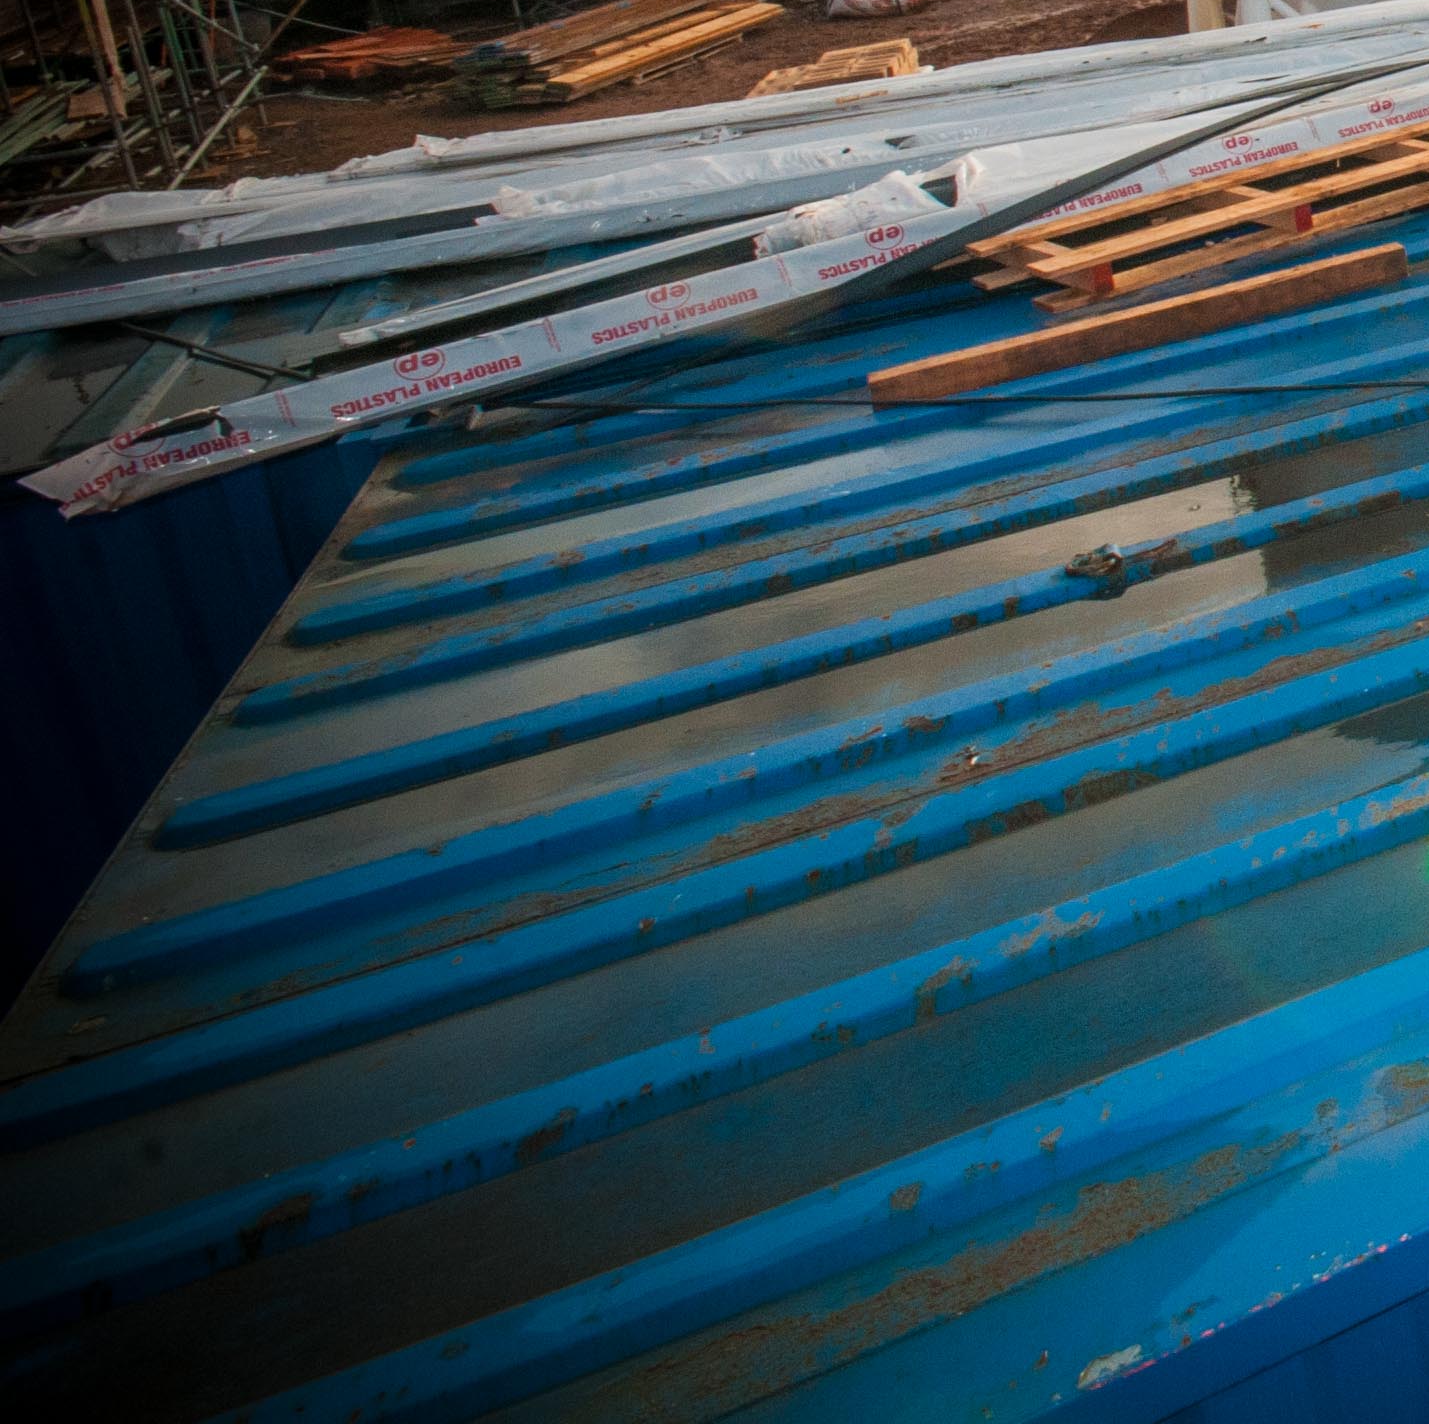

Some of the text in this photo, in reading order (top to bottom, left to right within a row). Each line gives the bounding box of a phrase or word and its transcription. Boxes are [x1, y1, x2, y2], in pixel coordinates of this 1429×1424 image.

[1370, 99, 1393, 114] ep
[1189, 141, 1298, 177] EUROPEAN PLASTICS
[1225, 136, 1252, 153] ep
[1079, 182, 1142, 214] EUROPEAN
[869, 225, 901, 244] ep
[818, 253, 887, 280] PLASTICS
[651, 284, 687, 305] ep
[675, 288, 758, 321] EUROPEAN
[592, 312, 671, 344] PLASTICS
[398, 352, 440, 375] ep
[426, 355, 521, 391] EUROPEAN
[331, 384, 420, 418] PLASTICS
[143, 429, 250, 472] EUROPEAN
